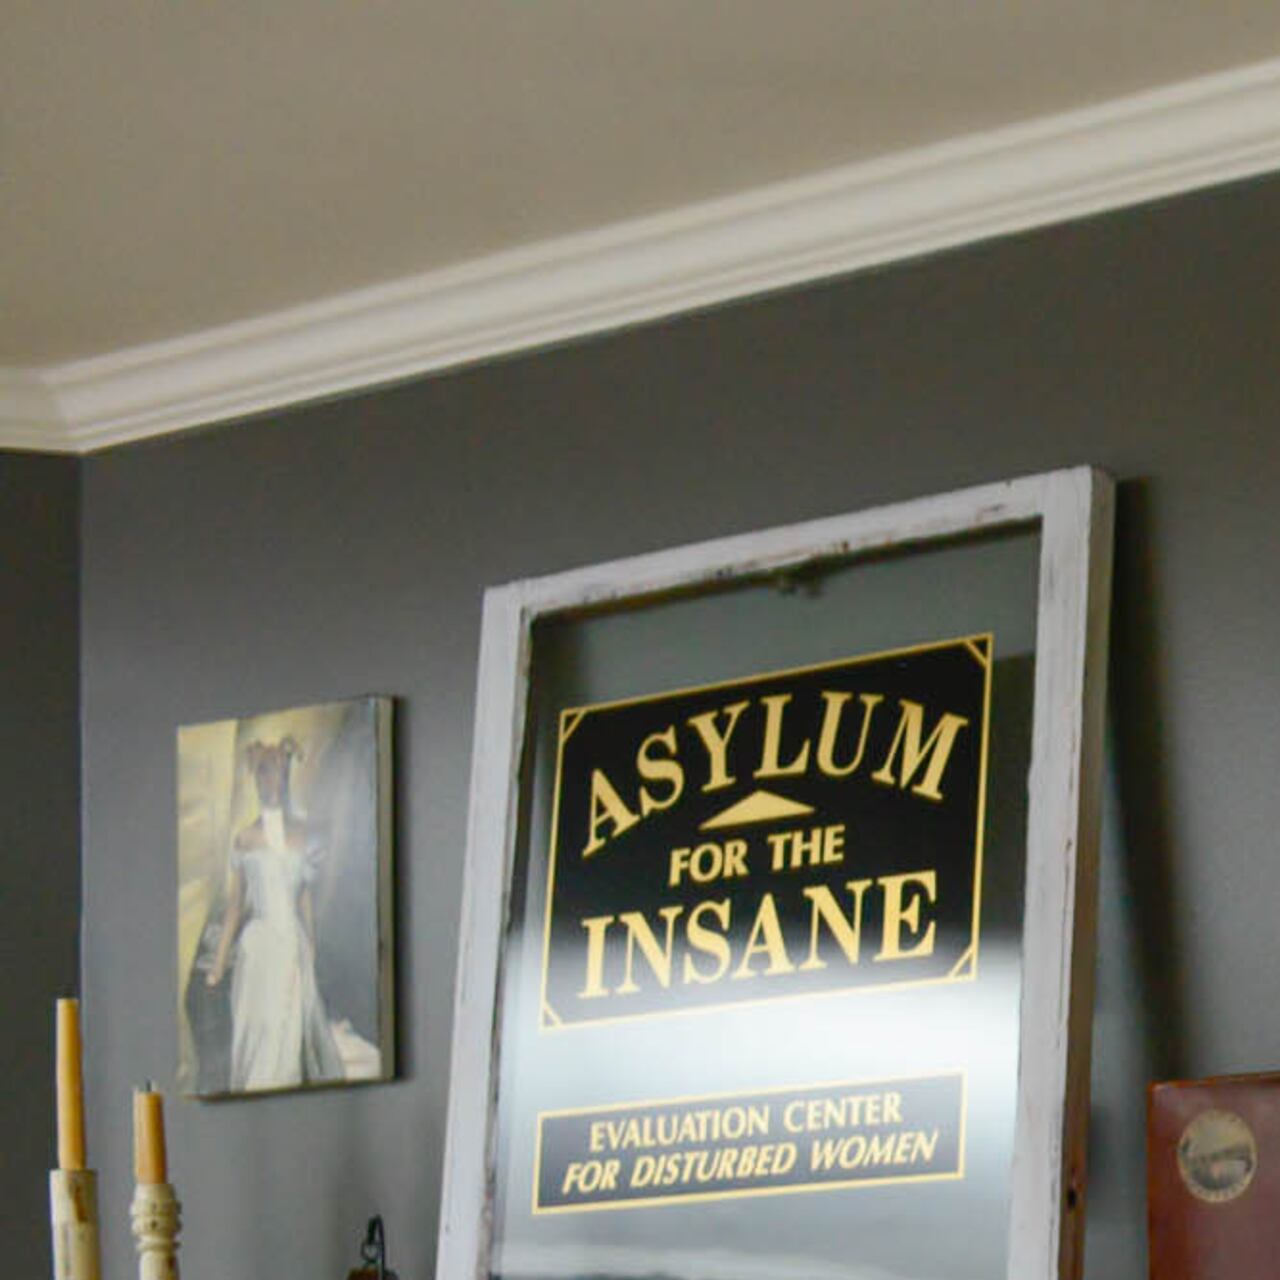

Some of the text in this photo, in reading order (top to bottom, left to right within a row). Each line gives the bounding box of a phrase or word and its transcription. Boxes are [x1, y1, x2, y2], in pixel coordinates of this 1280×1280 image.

[582, 690, 969, 858] ASYLUM
[668, 824, 846, 888] FOR THE
[577, 869, 938, 1000] INSANE
[589, 1091, 903, 1154] EVALUATION CENTER
[562, 1130, 940, 1195] FOR DISTURBED WOMEN
